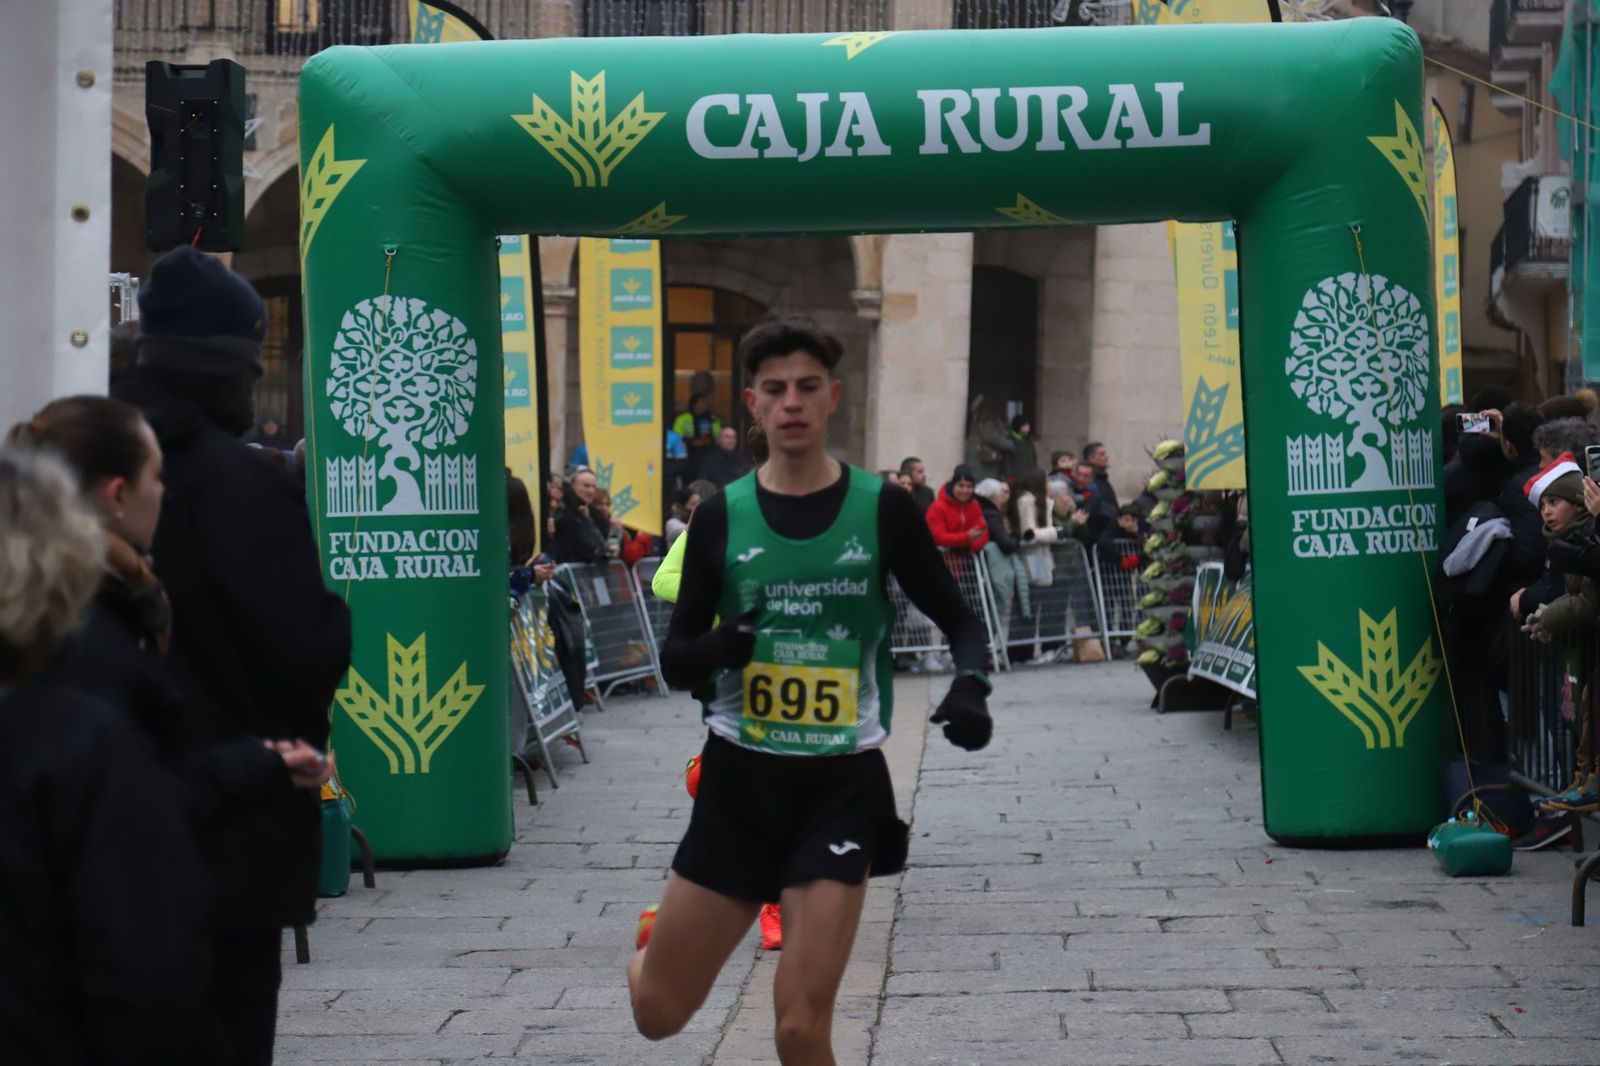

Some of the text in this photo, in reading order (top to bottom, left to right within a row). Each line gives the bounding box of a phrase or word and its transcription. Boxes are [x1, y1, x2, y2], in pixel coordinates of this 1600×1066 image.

[685, 82, 1211, 162] CAJA RURAL
[1291, 503, 1436, 533] FUNDACION
[329, 529, 480, 554] FUNDACION
[1292, 528, 1439, 559] CAJA RURAL
[329, 554, 481, 582] CAJA RURAL
[765, 578, 868, 598] universidad
[766, 598, 823, 615] de león
[749, 674, 840, 723] 695
[770, 729, 850, 745] CAJA RURAL
